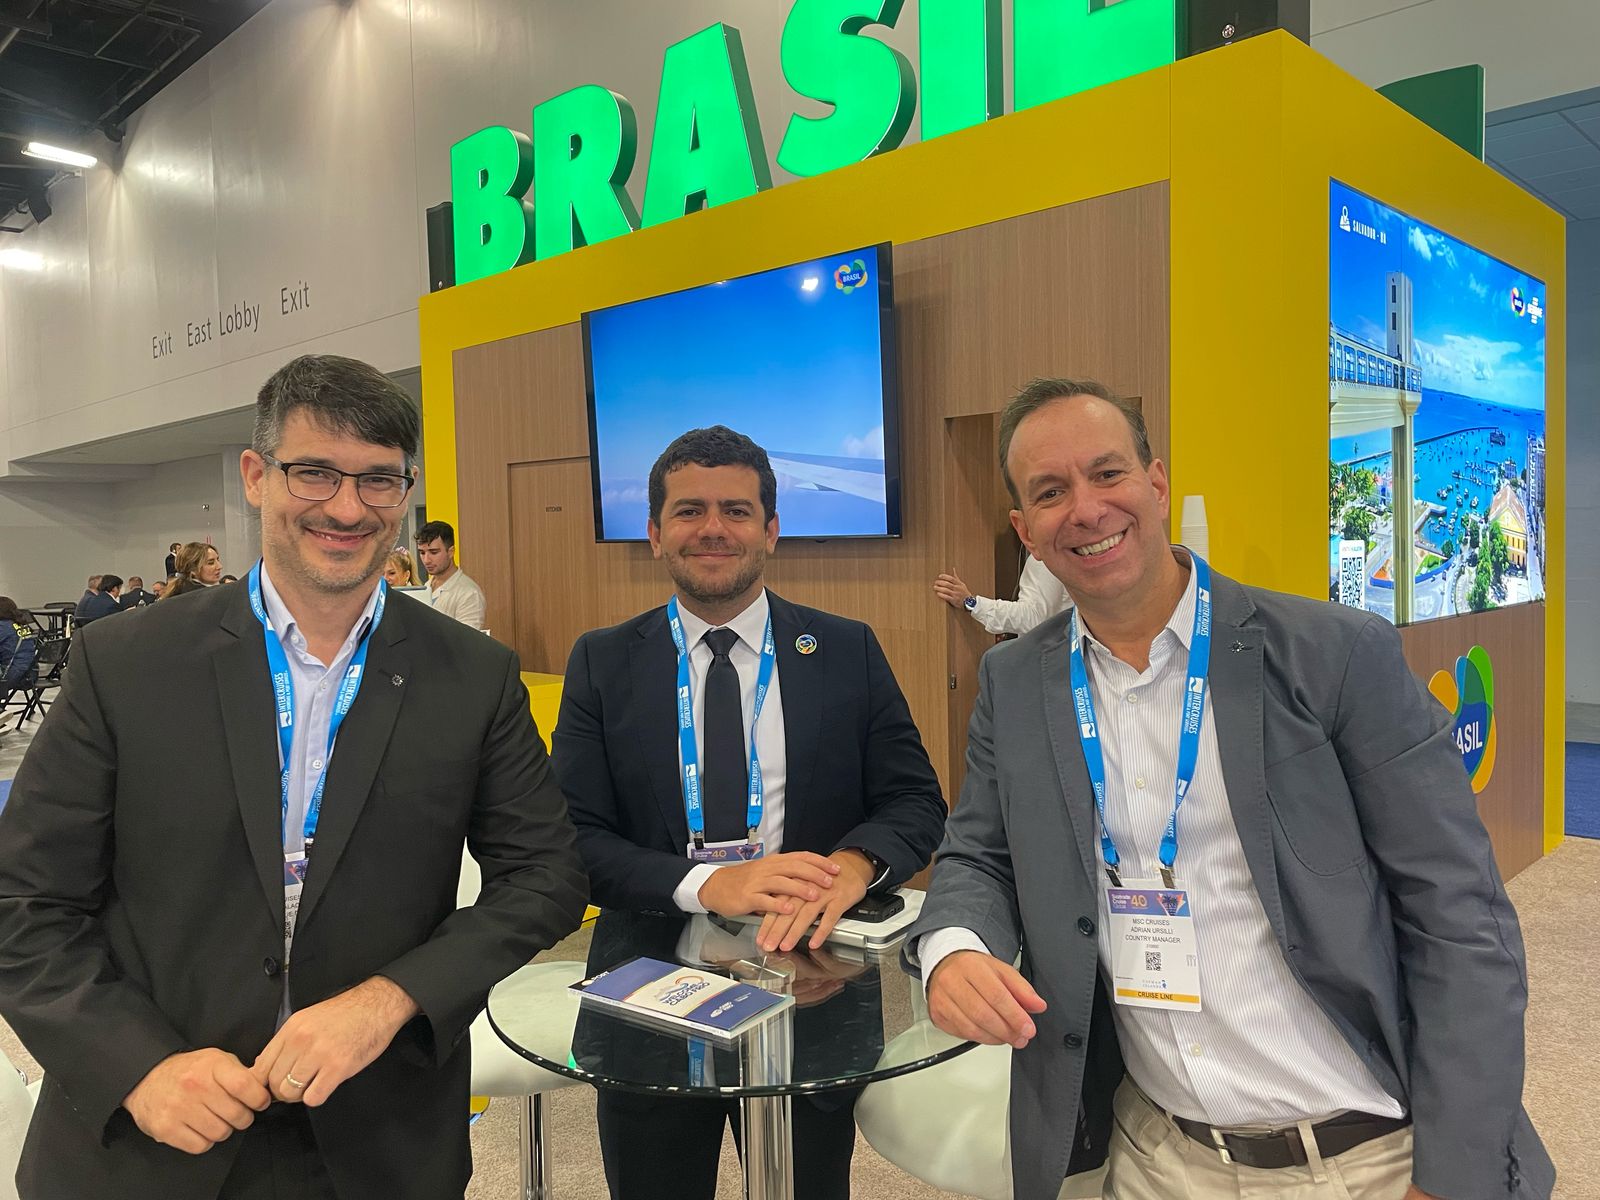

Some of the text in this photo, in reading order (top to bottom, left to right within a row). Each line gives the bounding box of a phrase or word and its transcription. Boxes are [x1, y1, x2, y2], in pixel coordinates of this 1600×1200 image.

[842, 272, 861, 283] BRASIL
[280, 280, 310, 315] Exit
[187, 300, 260, 347] East Lobby
[152, 331, 173, 359] Exit
[274, 672, 286, 713] INTERCRUISES
[341, 677, 358, 715] INTERCRUISES
[1074, 687, 1089, 724] INTERCRUISES
[1188, 692, 1203, 735] INTERCRUISES
[1452, 721, 1483, 755] ASIL
[711, 849, 727, 858] 40
[1131, 894, 1148, 907] 40
[1152, 936, 1181, 944] MANAGER
[1137, 991, 1158, 999] CRUISE
